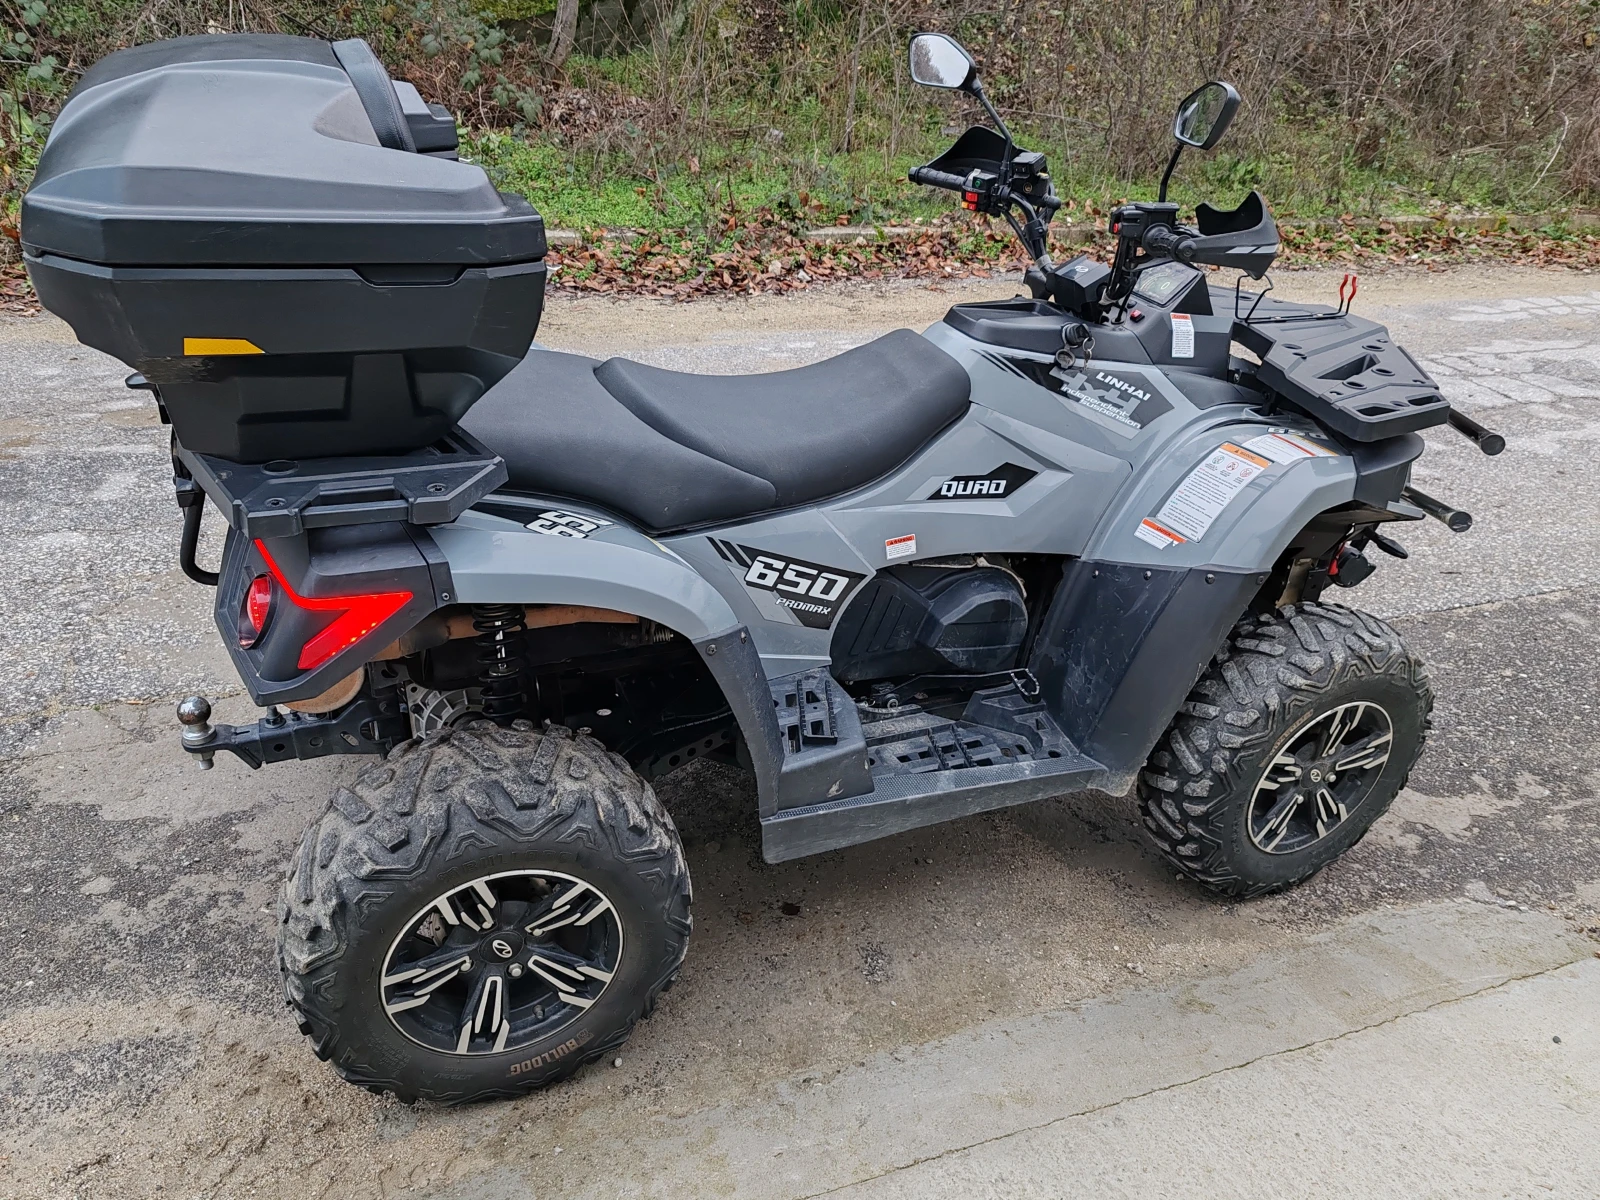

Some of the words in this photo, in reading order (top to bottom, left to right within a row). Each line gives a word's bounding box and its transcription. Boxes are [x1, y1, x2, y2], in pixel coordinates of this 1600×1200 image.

[1060, 383, 1130, 417] Independent
[1096, 371, 1152, 401] LINHAI
[940, 479, 1007, 497] QUAD
[744, 556, 849, 602] 650
[775, 597, 831, 615] PROMAX
[510, 1038, 579, 1076] BULLDOG
